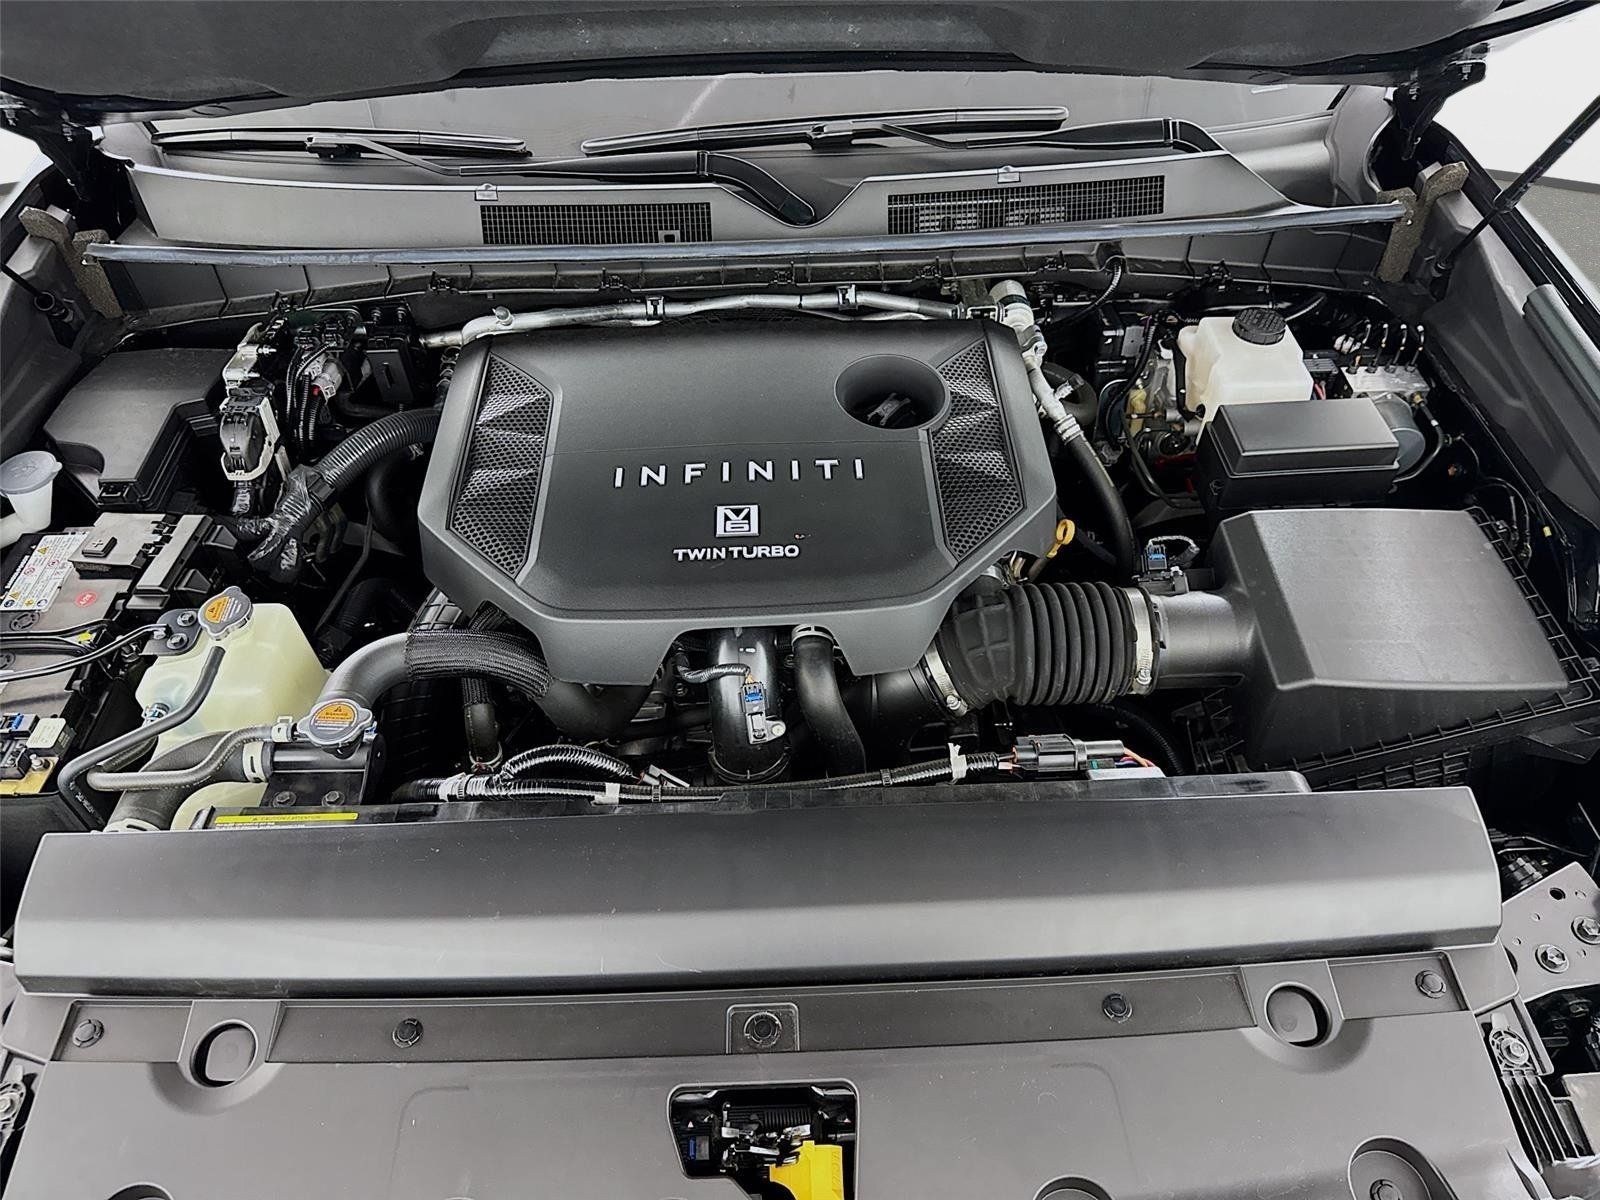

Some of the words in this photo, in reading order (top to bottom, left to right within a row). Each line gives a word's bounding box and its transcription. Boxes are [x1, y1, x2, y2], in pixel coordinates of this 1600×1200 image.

[614, 458, 865, 488] INFINITI
[673, 547, 726, 562] TWIN
[729, 544, 800, 559] TURBO
